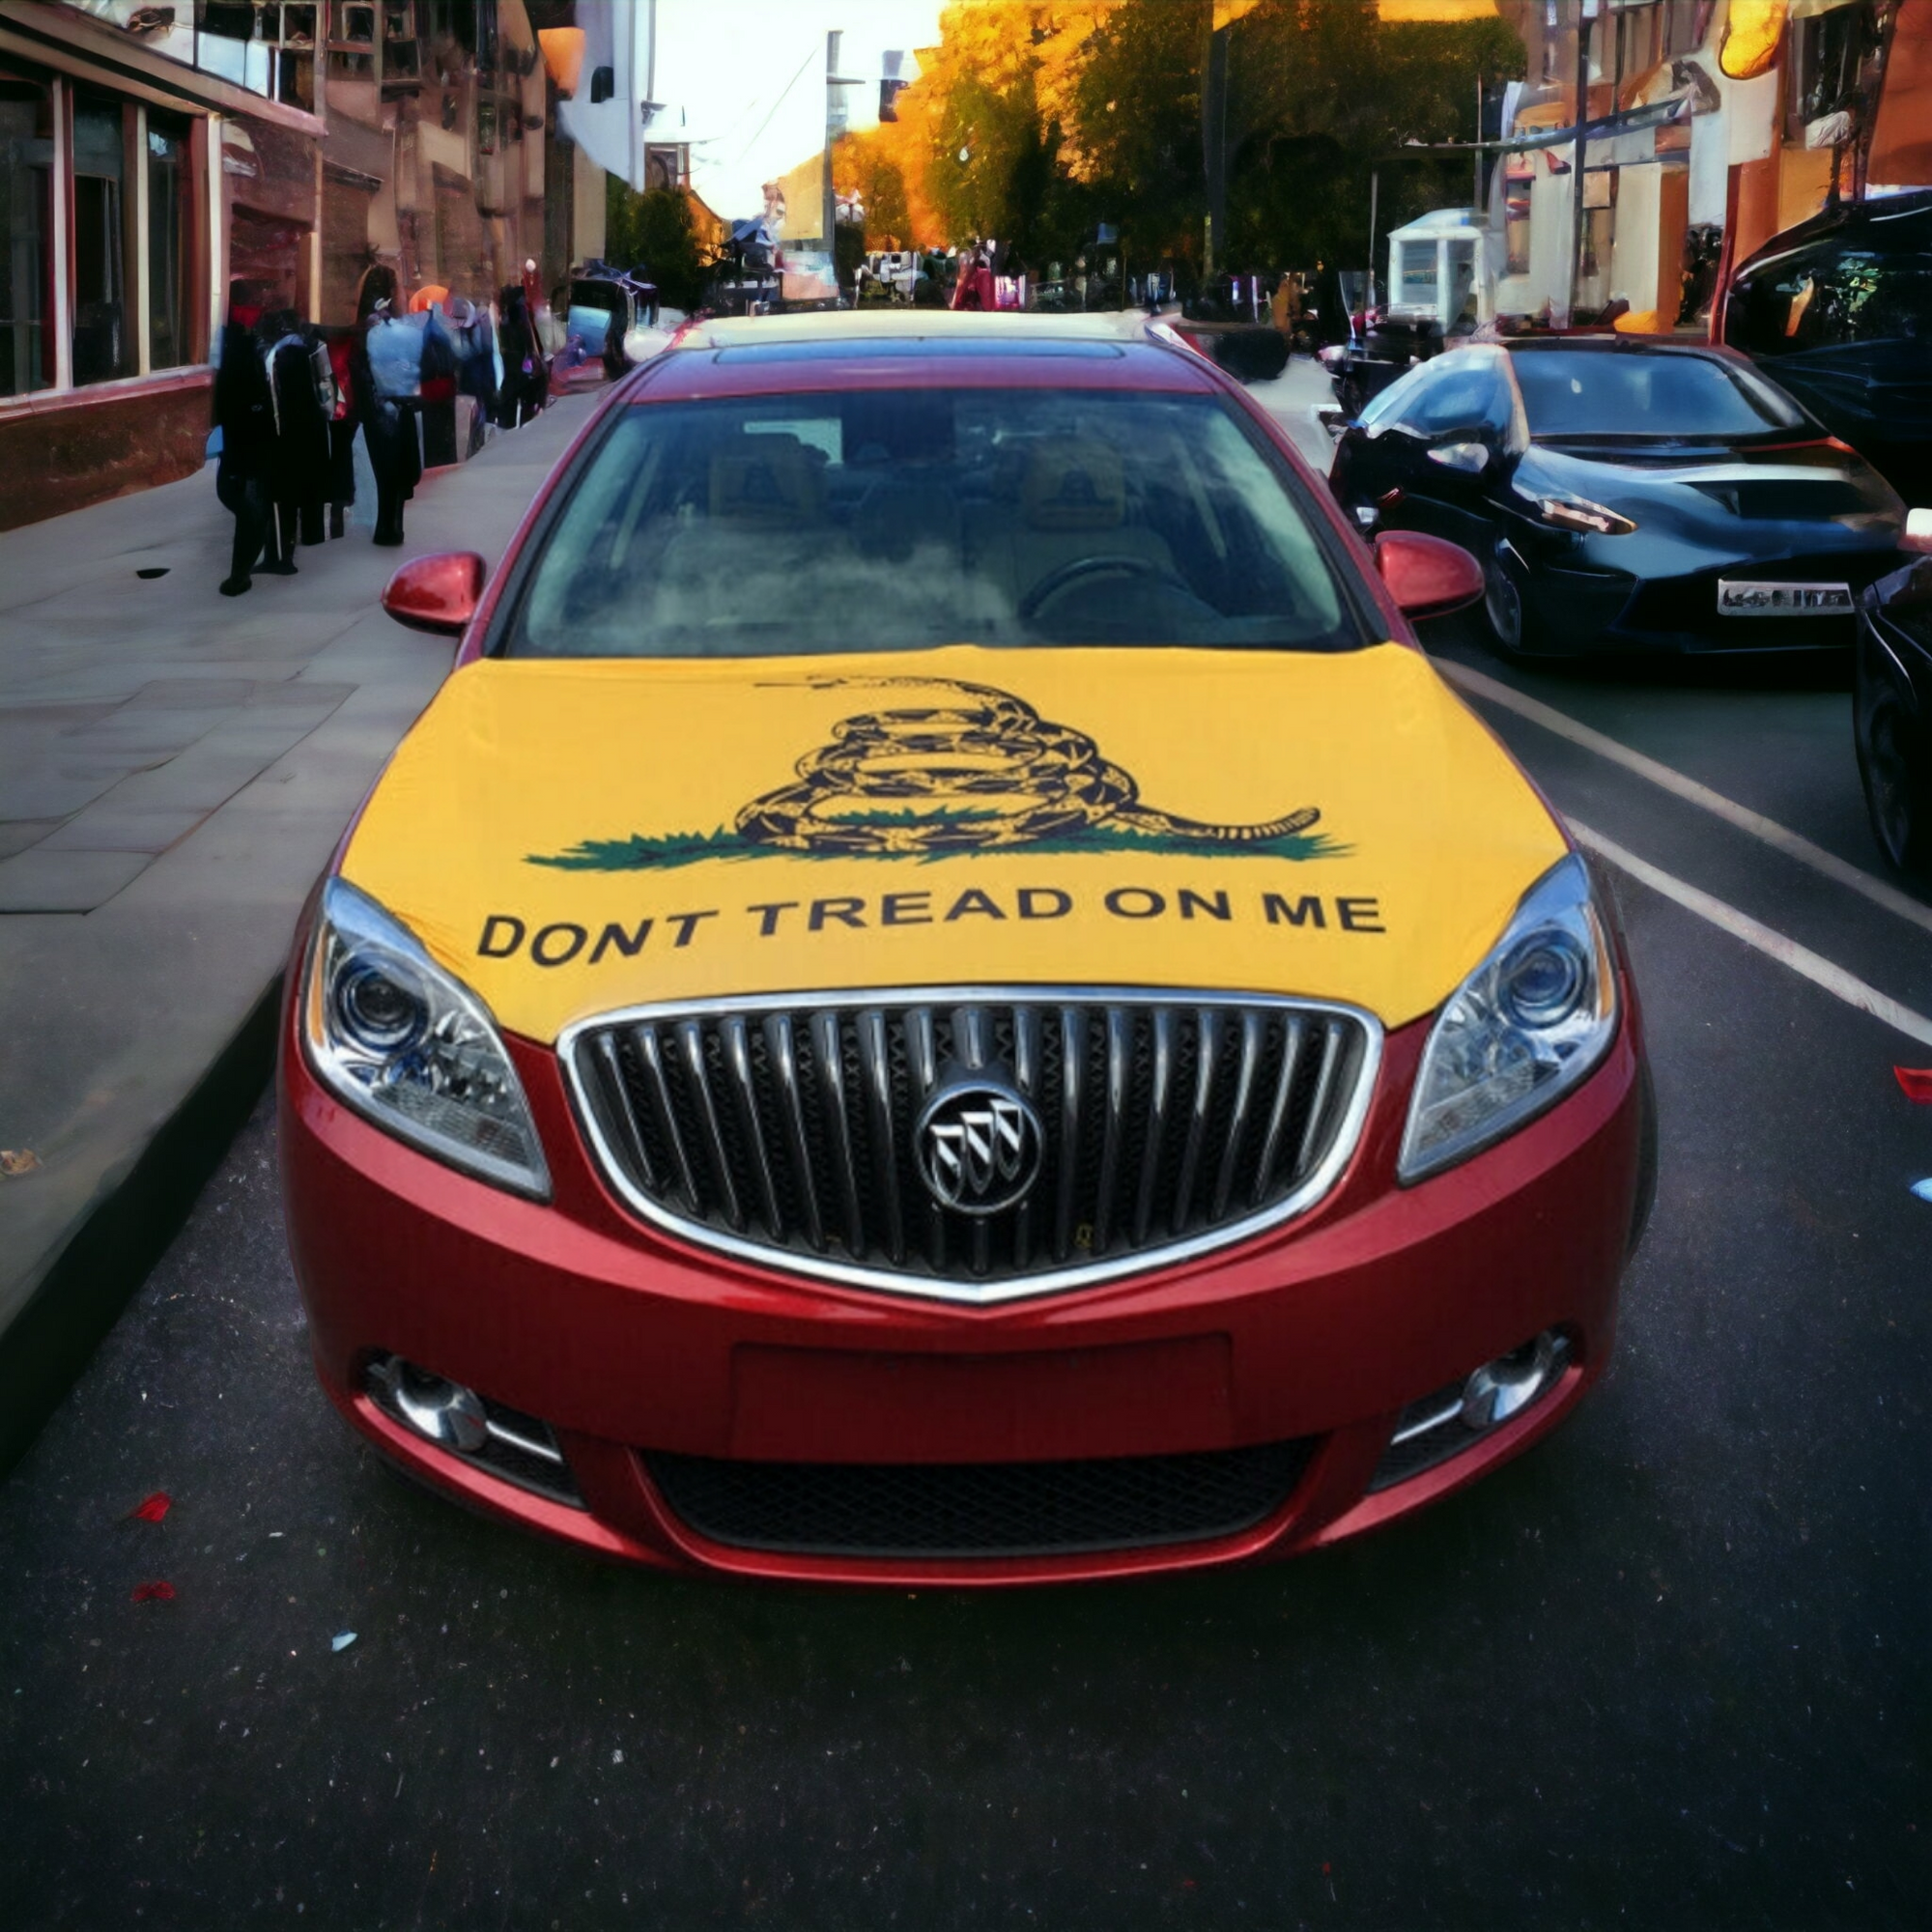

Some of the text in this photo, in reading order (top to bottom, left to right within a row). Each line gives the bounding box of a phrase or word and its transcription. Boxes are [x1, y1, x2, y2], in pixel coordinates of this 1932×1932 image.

[476, 887, 1386, 967] DONT TREAD ON ME
